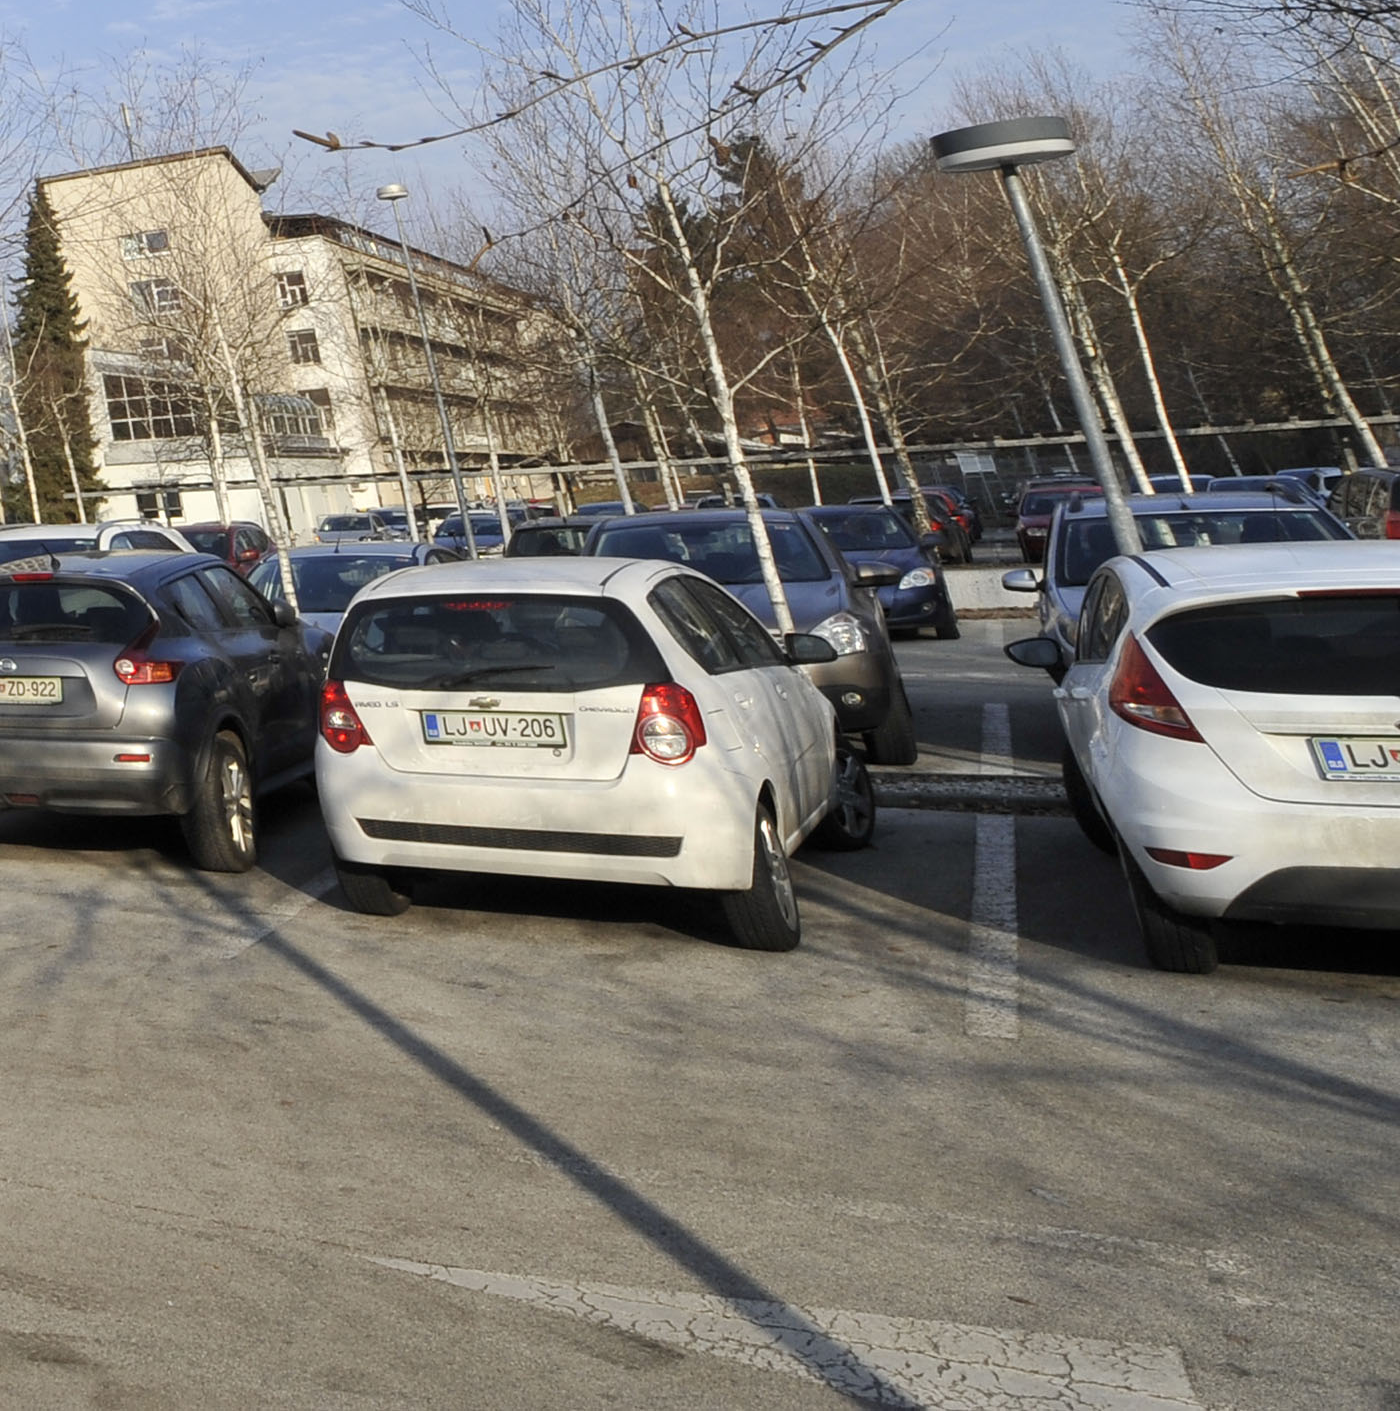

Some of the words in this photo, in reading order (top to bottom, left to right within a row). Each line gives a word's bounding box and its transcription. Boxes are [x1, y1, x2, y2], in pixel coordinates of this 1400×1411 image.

[7, 681, 57, 698] ZD-922
[442, 716, 468, 737] LJ
[482, 716, 556, 739] UV-206
[1345, 744, 1390, 768] LJ
